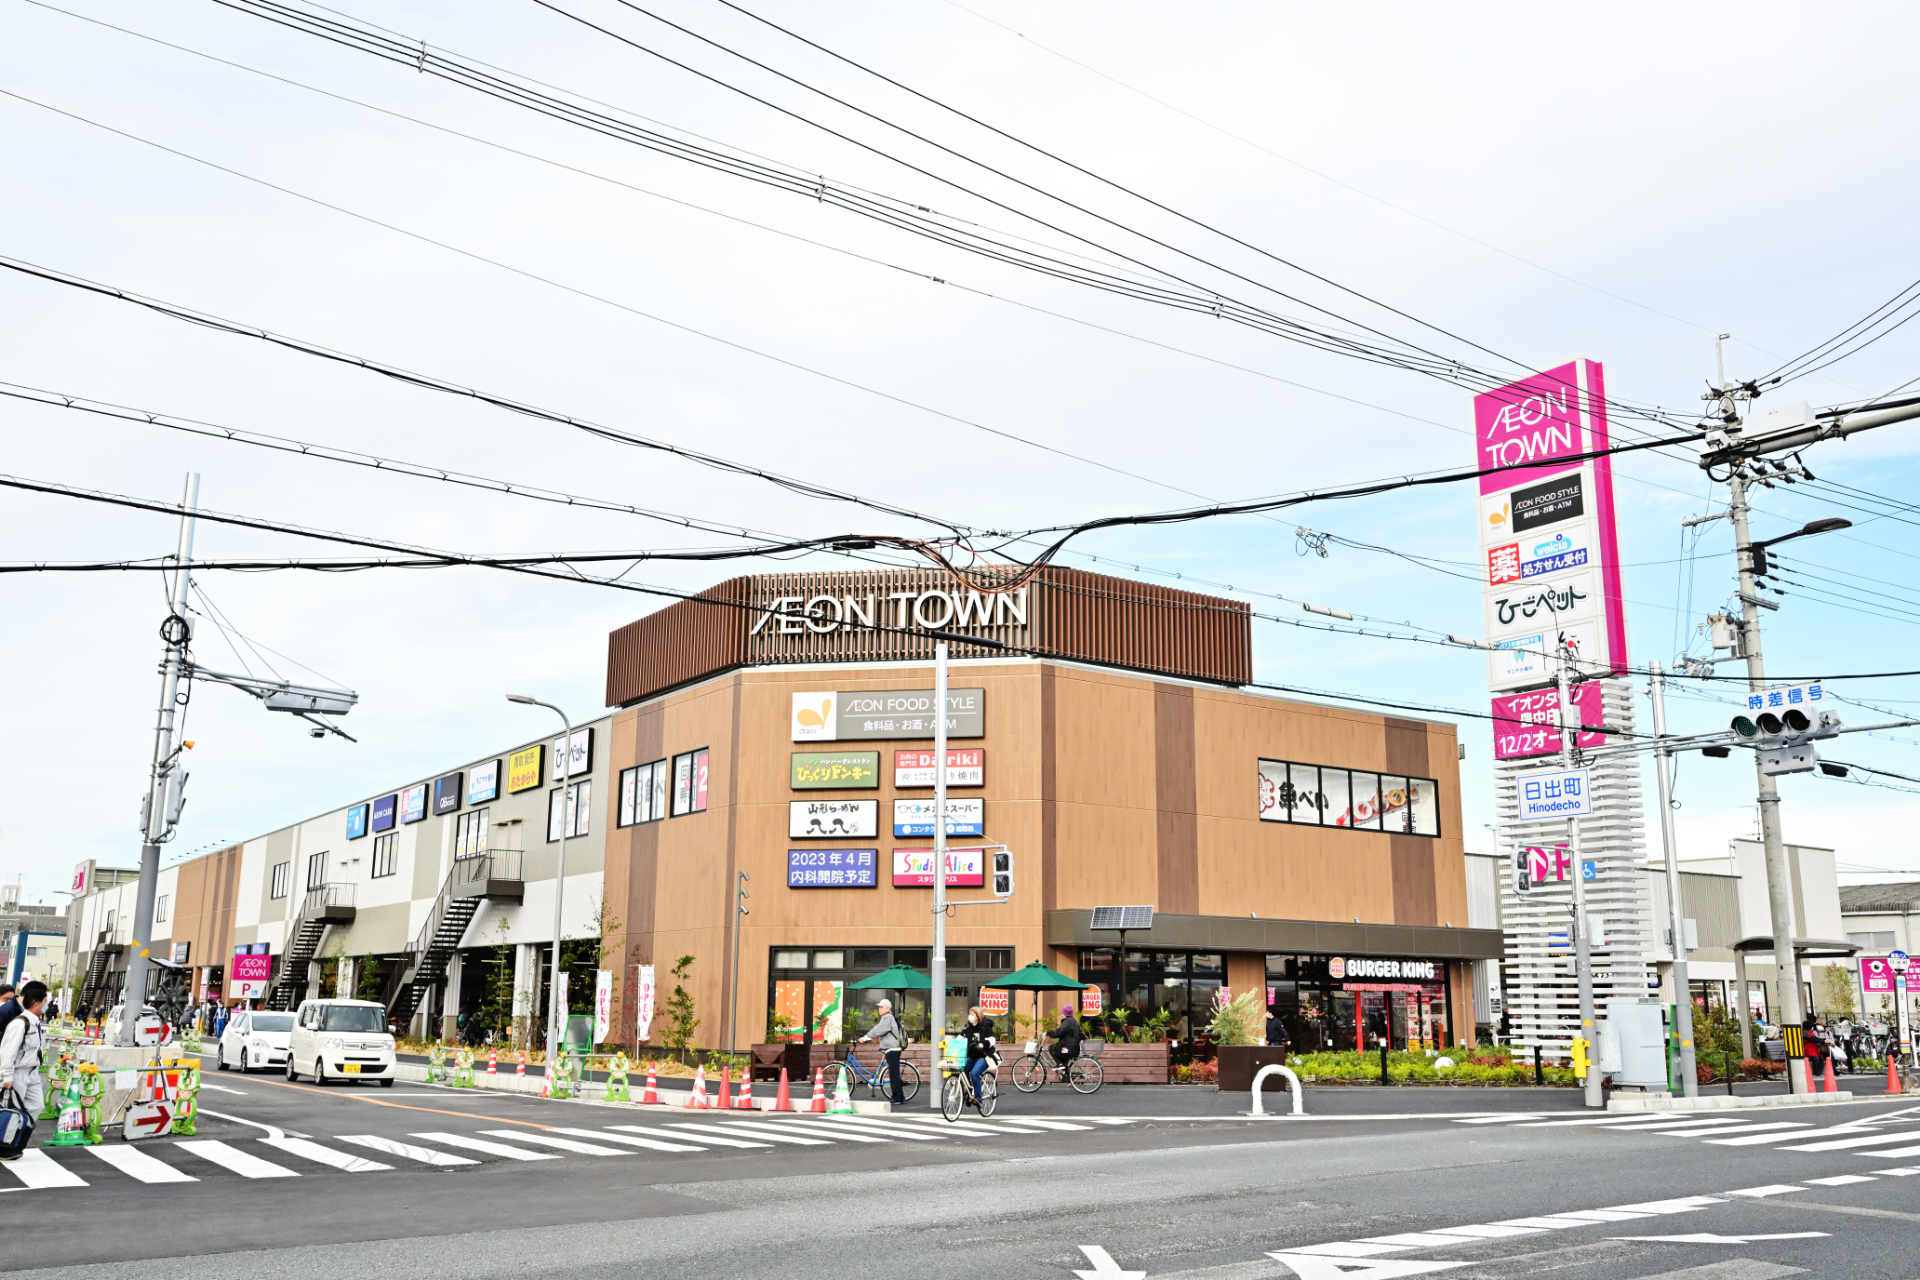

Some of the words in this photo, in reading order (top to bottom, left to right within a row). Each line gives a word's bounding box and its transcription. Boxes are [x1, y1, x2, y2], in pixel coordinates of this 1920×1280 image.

[1486, 421, 1571, 468] TOWN
[1535, 493, 1556, 505] FOOD
[1557, 485, 1579, 498] STYLE
[1536, 542, 1568, 556] welcia
[1490, 547, 1520, 582] 薬
[1522, 550, 1586, 576] 処方せん受付
[890, 587, 1027, 629] TOWN
[1495, 585, 1587, 624] ひごペット
[888, 698, 929, 711] FOOD
[1508, 689, 1583, 712] イオンタン
[1748, 685, 1823, 710] 時差信号
[863, 719, 957, 732] 食料品・お酒・AM
[920, 752, 978, 766] Dariki
[796, 764, 872, 782] びっくりドンキー
[1525, 777, 1581, 800] 日出町
[807, 803, 860, 815] 山形らーめん
[1528, 800, 1581, 813] Hinodecho
[903, 854, 934, 873] Studi
[791, 870, 871, 884] 内科開院予定
[239, 968, 266, 977] TOWN
[1348, 960, 1401, 977] BURGER
[1403, 962, 1434, 979] KING
[242, 983, 251, 996] P
[642, 982, 650, 1022] OPEN
[980, 1000, 1008, 1009] KING
